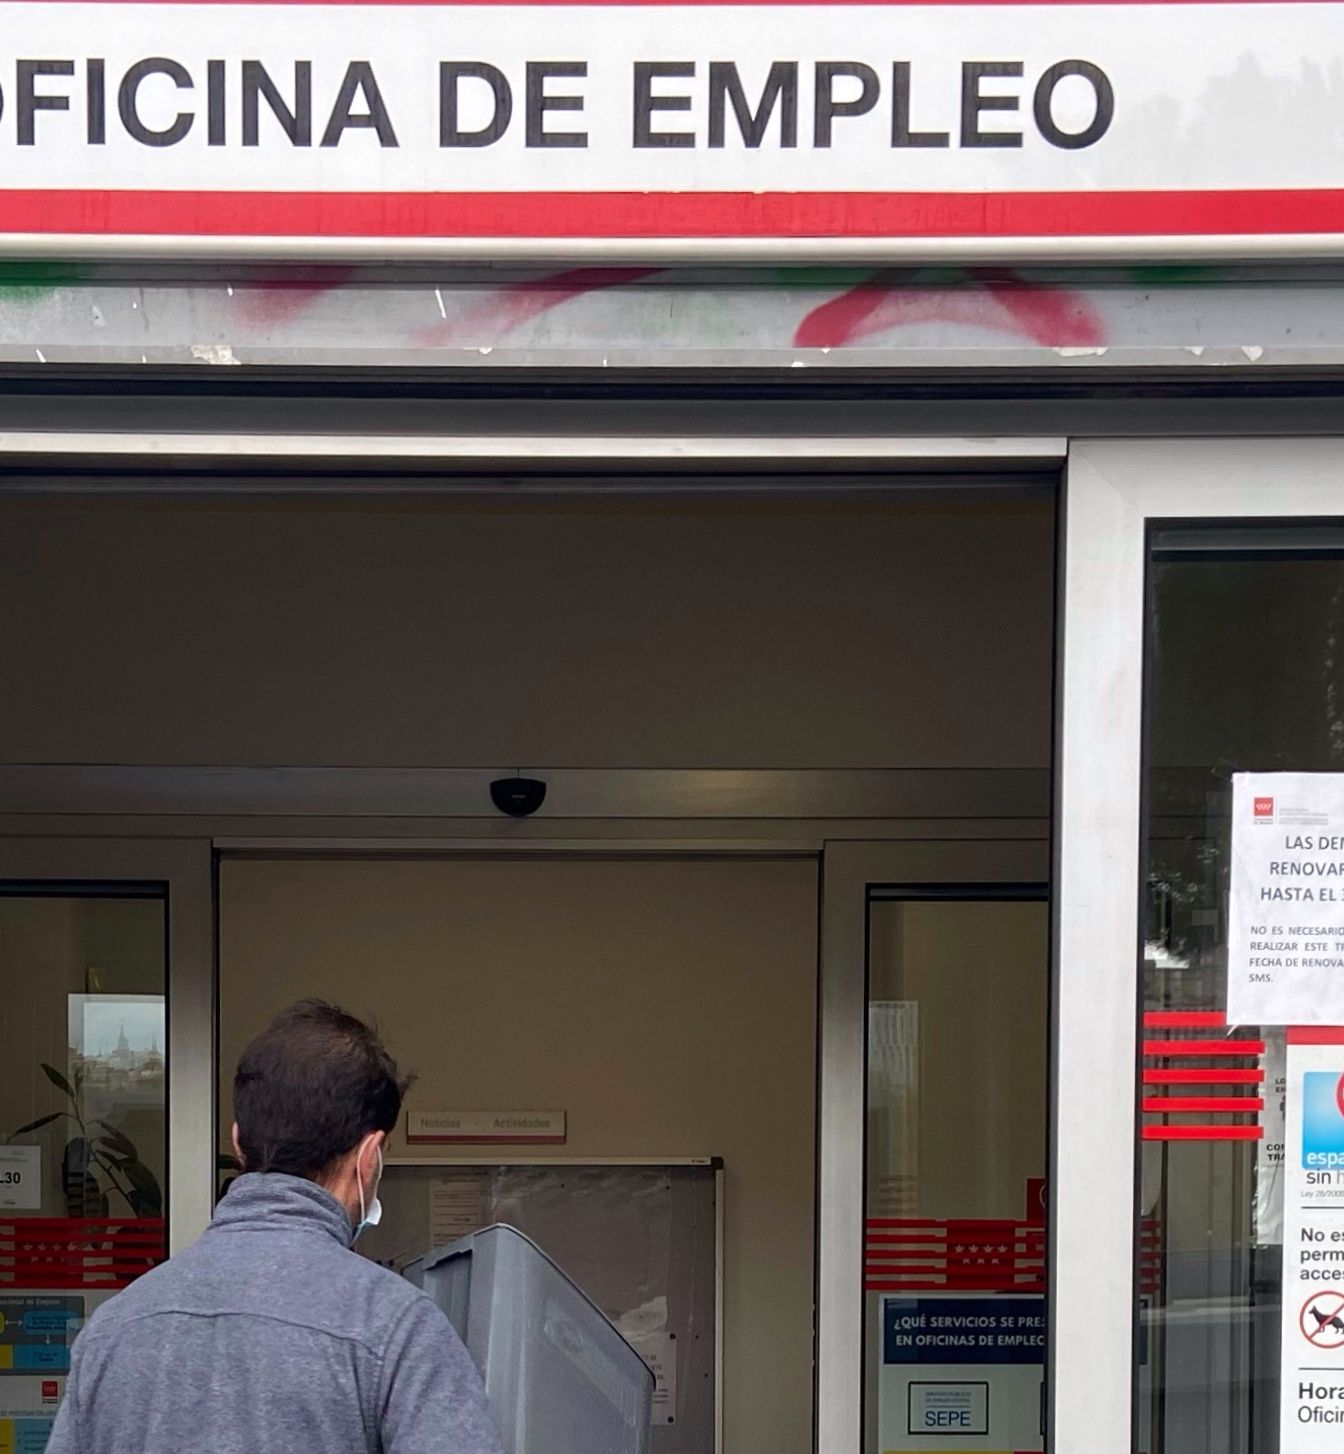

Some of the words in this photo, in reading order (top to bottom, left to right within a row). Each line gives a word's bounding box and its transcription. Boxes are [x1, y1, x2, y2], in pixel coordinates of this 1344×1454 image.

[439, 61, 588, 148] DE
[632, 59, 1114, 150] EMPLEO
[1285, 835, 1313, 849] LAS
[1260, 887, 1314, 901] HASTA
[1319, 887, 1336, 901] EL
[1306, 1168, 1331, 1184] sin
[1301, 1227, 1324, 1241] No
[894, 1313, 926, 1330] ¿QUÉ
[930, 1316, 996, 1327] SERVICIOS
[1000, 1316, 1014, 1327] SE
[1018, 1316, 1045, 1327] PRE
[896, 1334, 912, 1345] EN
[915, 1334, 975, 1345] OFICINAS
[978, 1335, 993, 1345] DE
[925, 1411, 971, 1427] SEPE
